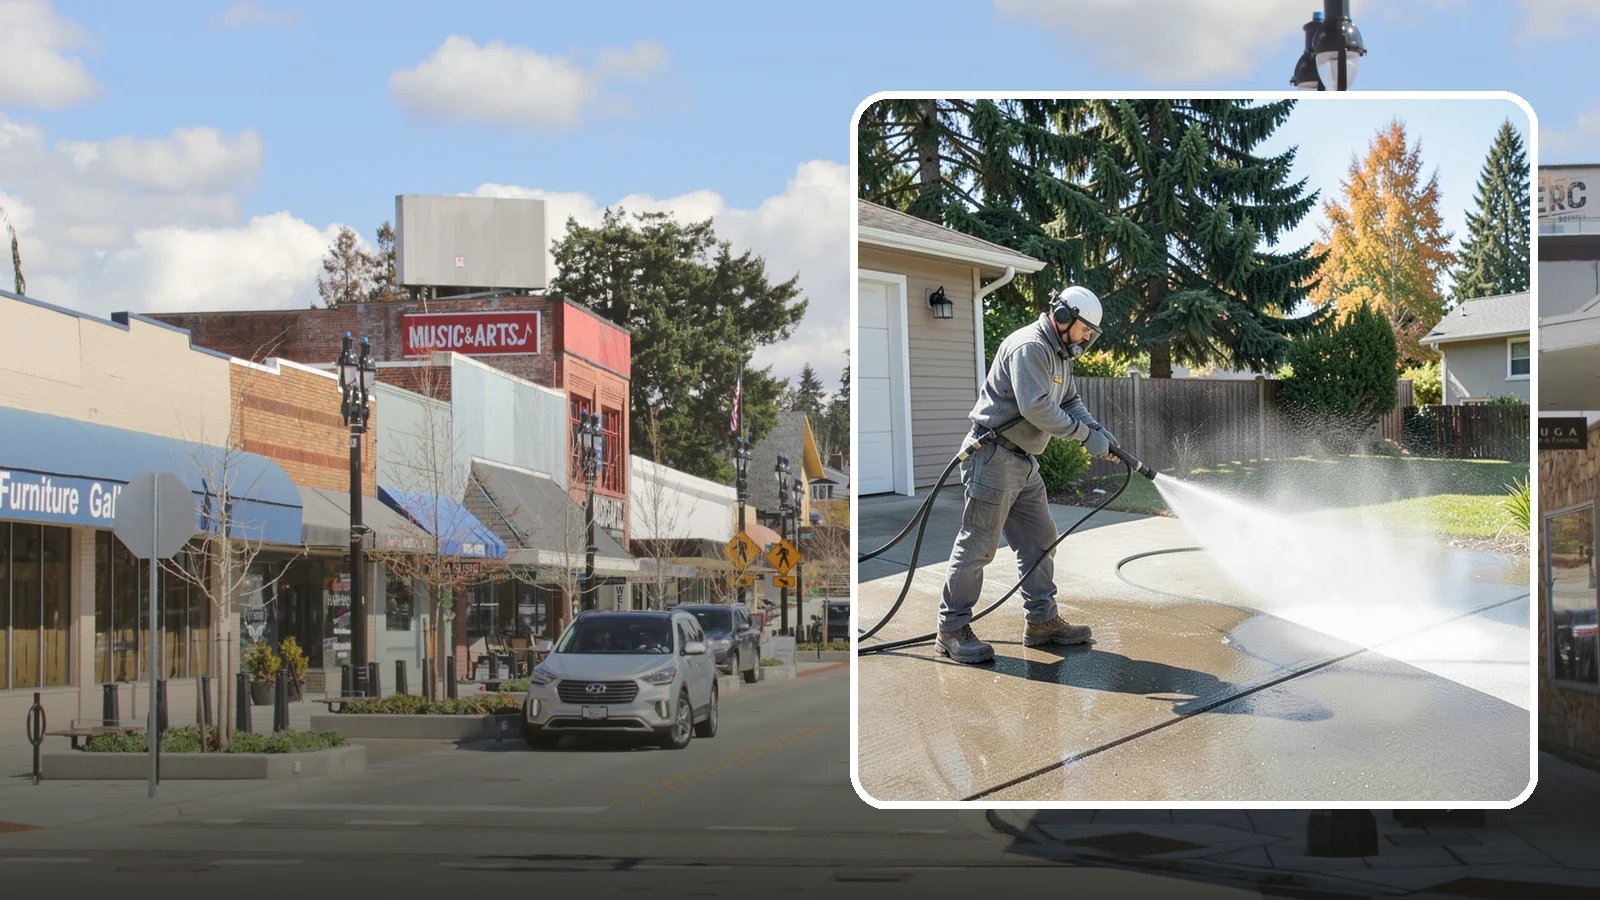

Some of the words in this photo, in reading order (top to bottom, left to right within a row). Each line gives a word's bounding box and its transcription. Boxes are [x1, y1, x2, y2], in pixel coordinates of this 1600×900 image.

[1540, 427, 1577, 436] UGA
[0, 471, 80, 516] Furniture
[89, 482, 122, 519] Gal
[453, 563, 480, 574] SUSHI
